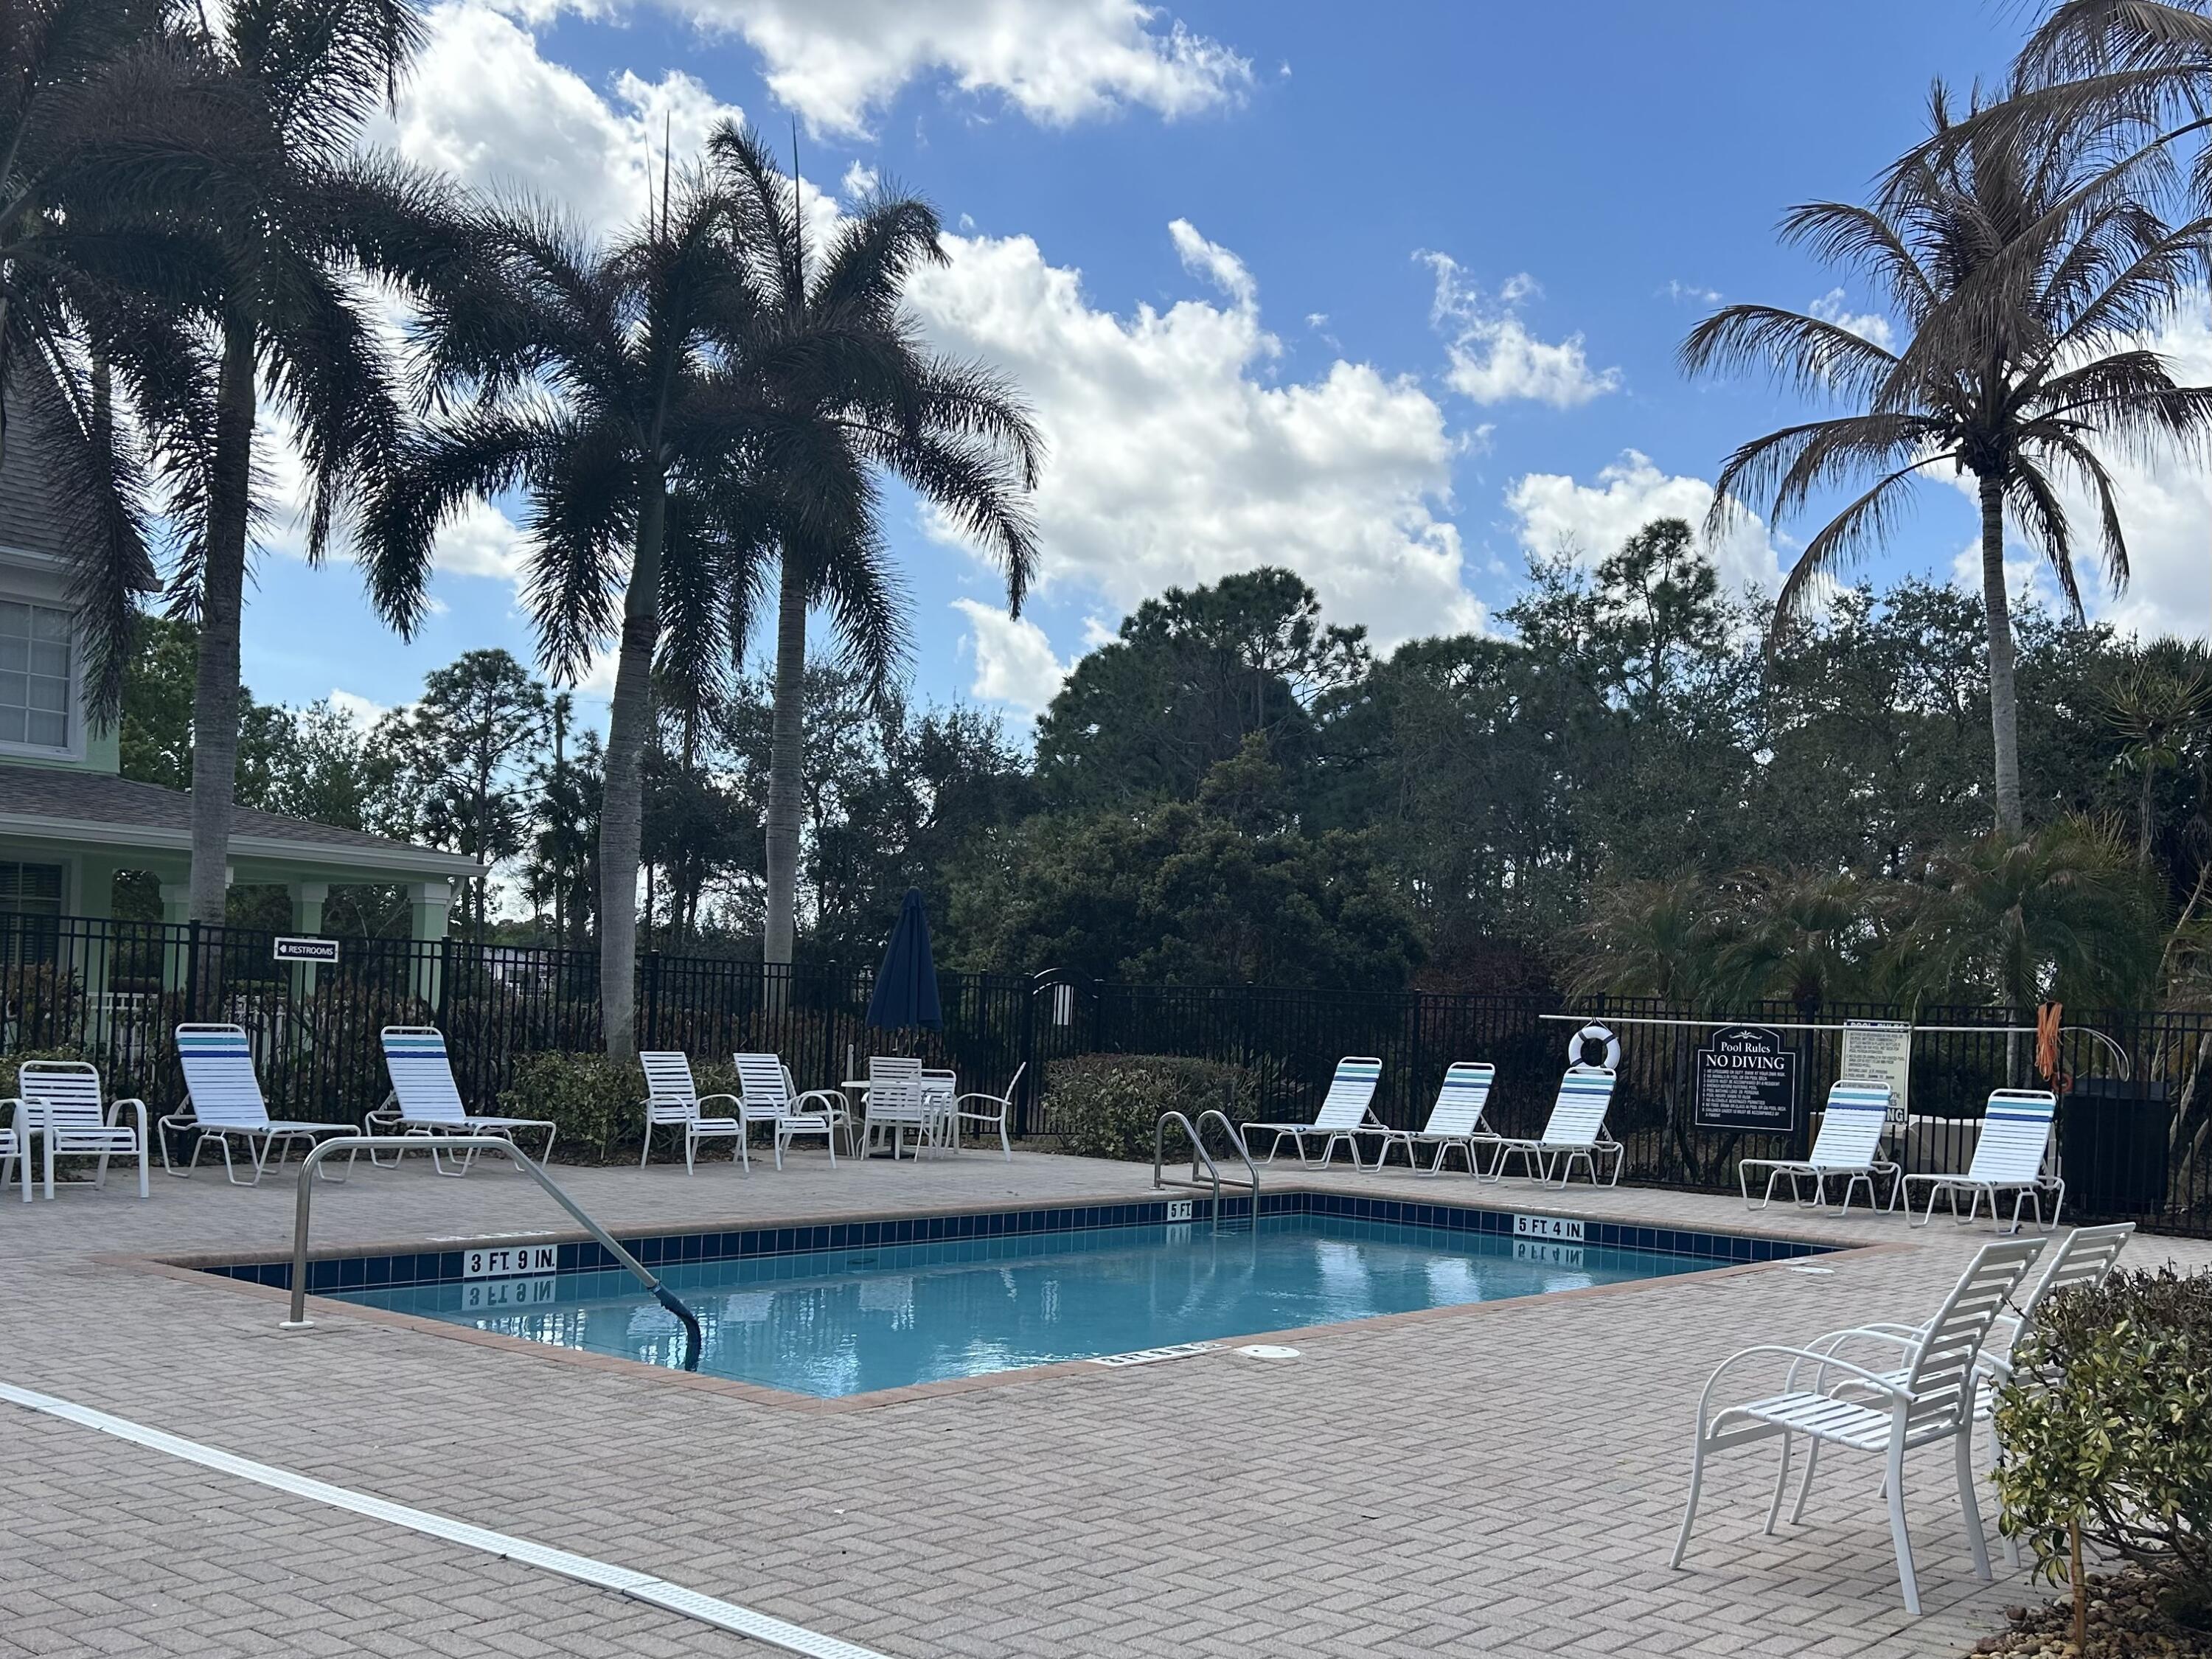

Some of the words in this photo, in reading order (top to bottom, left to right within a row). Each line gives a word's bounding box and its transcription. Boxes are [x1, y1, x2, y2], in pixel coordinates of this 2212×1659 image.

[288, 945, 333, 956] RESTROOMS
[1721, 1041, 1742, 1052] Pool
[1745, 1042, 1770, 1054] Rules
[1705, 1054, 1728, 1067] NO
[1732, 1055, 1785, 1070] DIVING
[1171, 1204, 1177, 1217] 5
[1519, 1217, 1527, 1231] 5
[1553, 1222, 1561, 1236] 4
[1567, 1222, 1583, 1238] IN.
[471, 1253, 481, 1273] 3
[490, 1251, 509, 1271] FT.
[518, 1250, 528, 1270] 9
[535, 1248, 555, 1268] IN.
